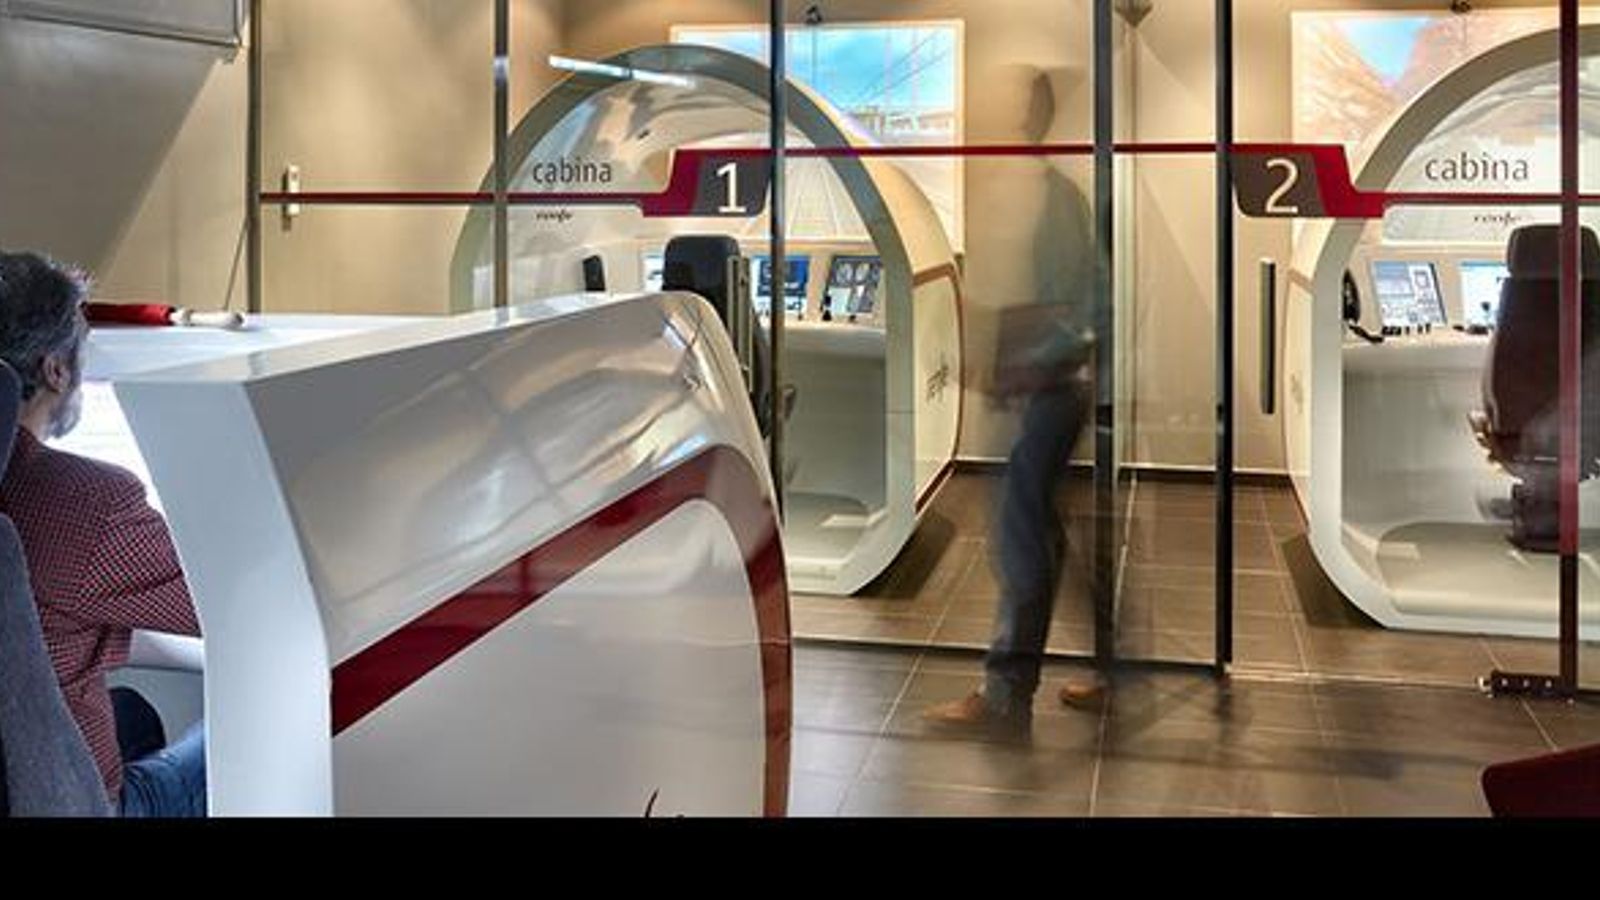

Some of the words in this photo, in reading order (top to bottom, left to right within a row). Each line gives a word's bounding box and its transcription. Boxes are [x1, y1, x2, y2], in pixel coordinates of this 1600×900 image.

[532, 158, 613, 184] cabina
[715, 162, 747, 214] 1
[1265, 158, 1299, 214] 2
[1424, 152, 1529, 181] cabina
